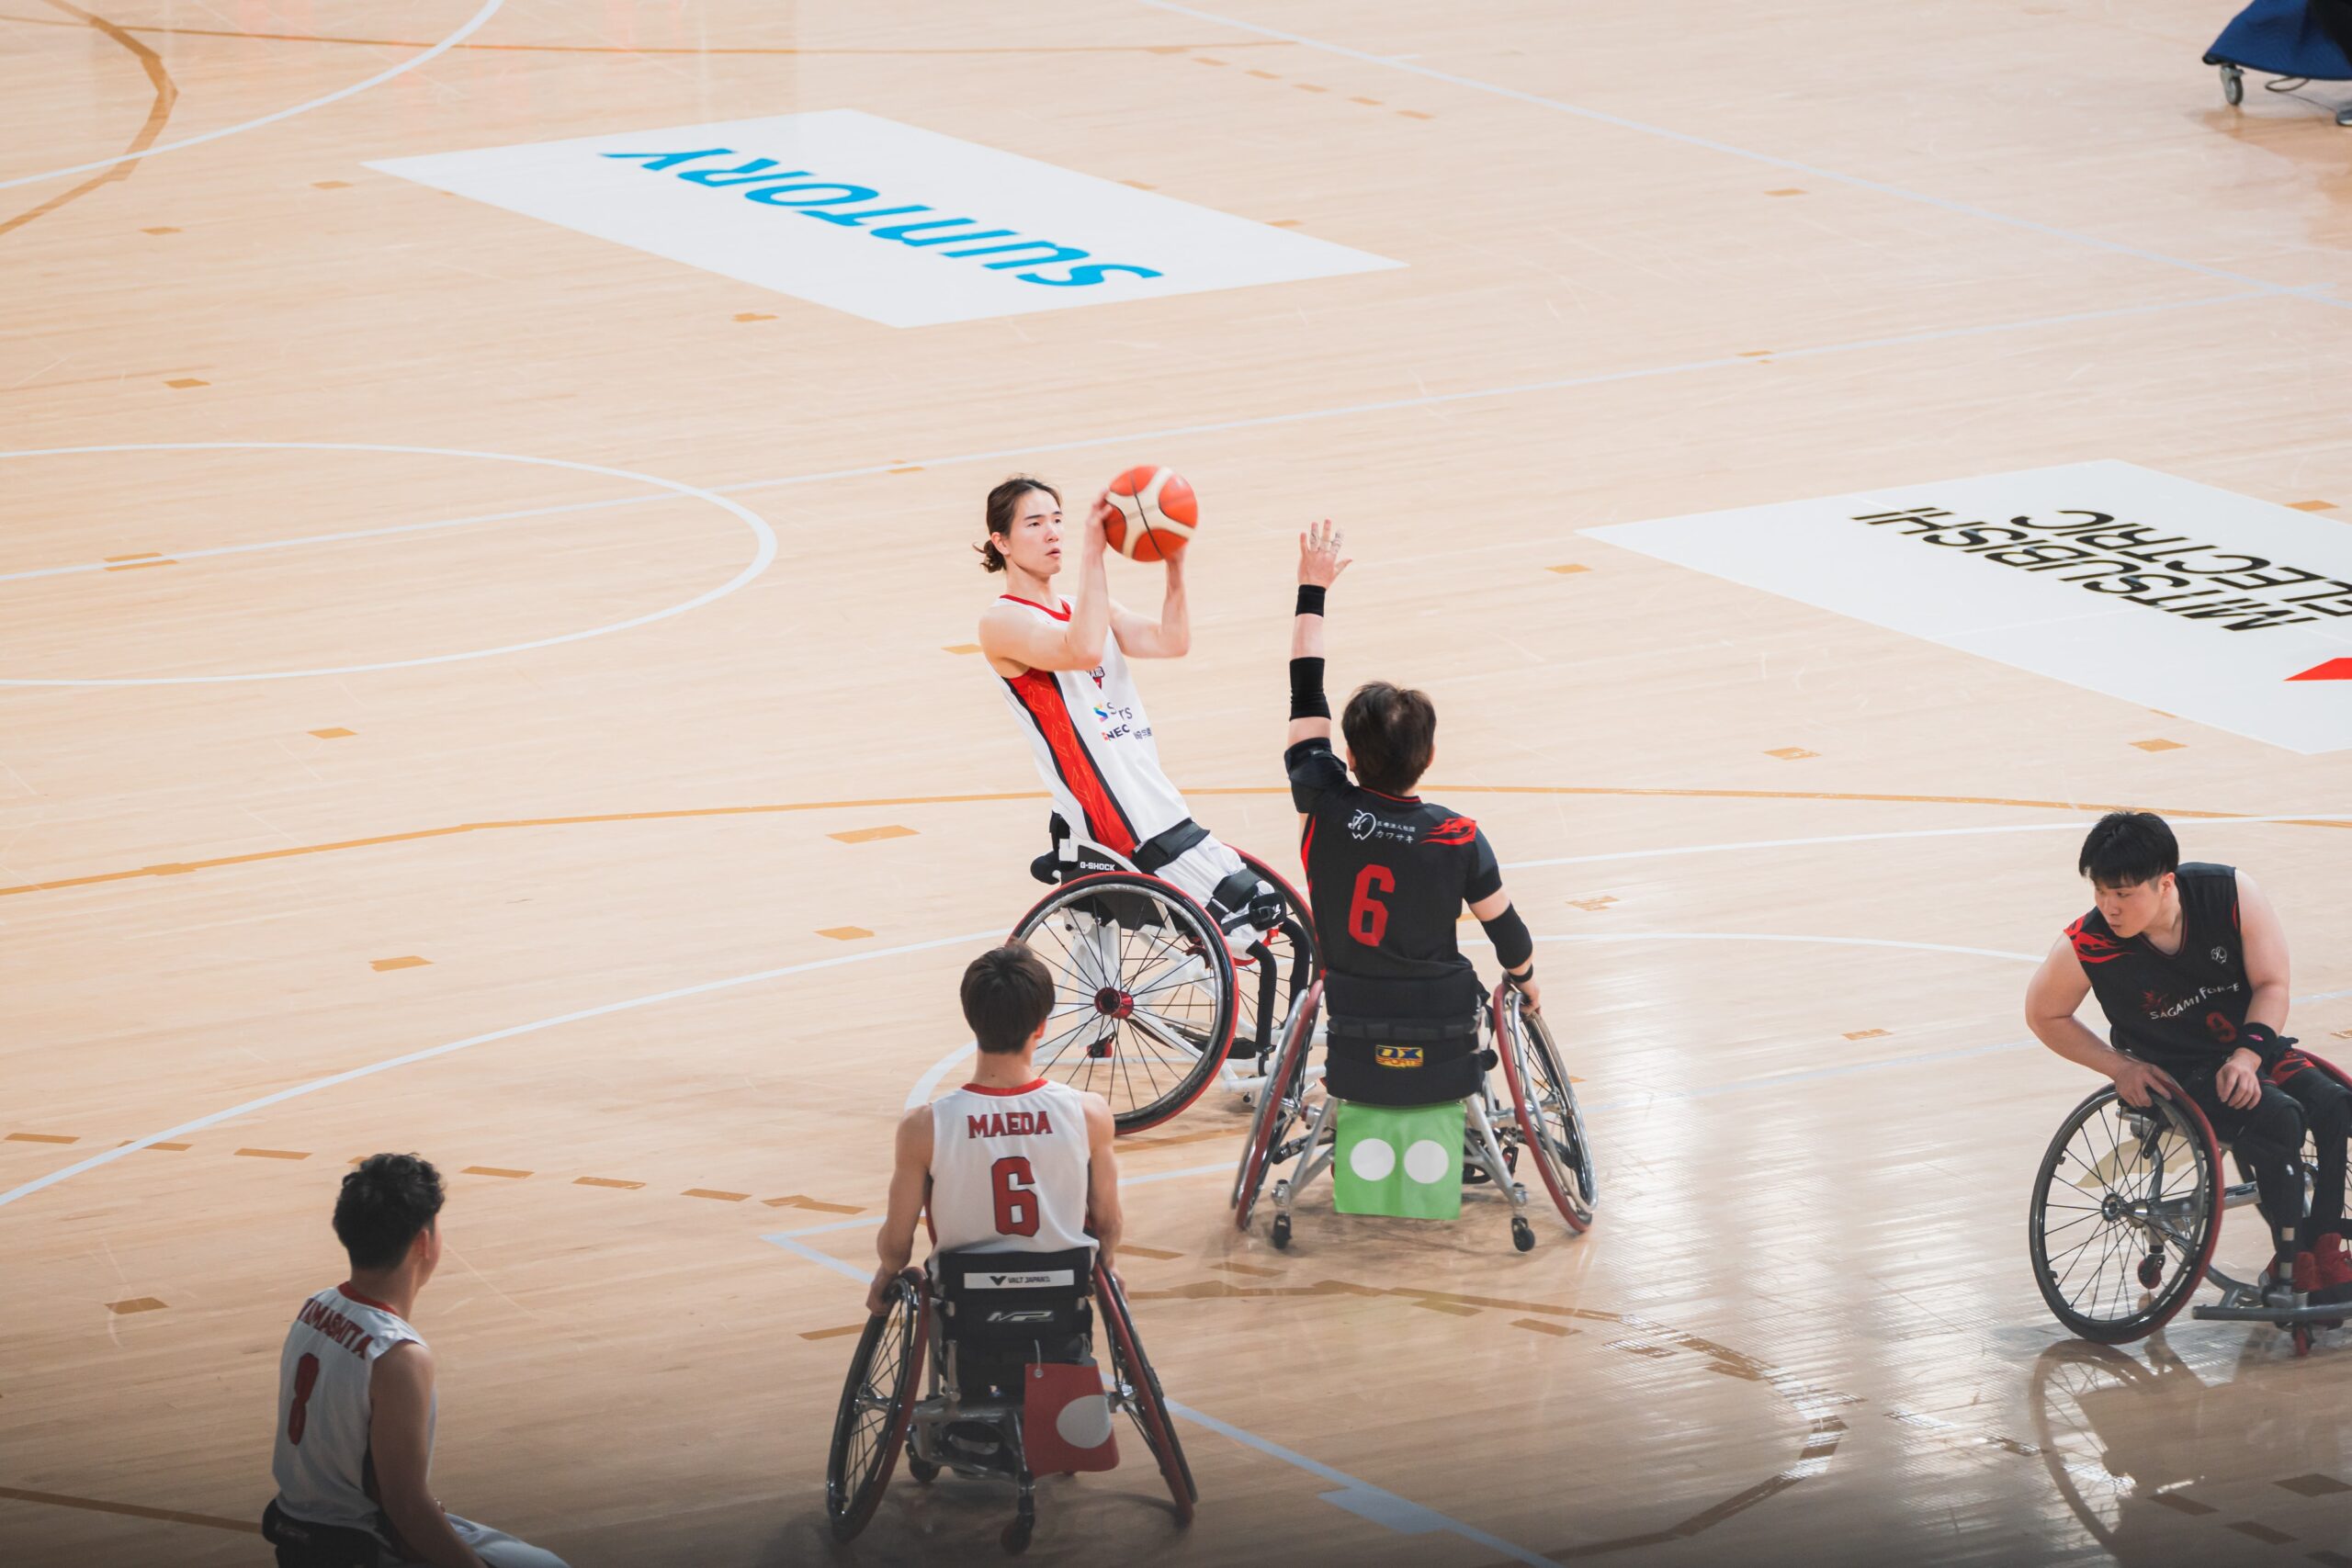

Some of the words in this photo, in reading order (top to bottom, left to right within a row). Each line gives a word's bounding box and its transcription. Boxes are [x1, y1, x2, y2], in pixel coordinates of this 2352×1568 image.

[597, 148, 1164, 287] SUNTORY
[1850, 507, 2319, 631] MITSUBISHI
[1375, 830, 1414, 844] カワサキ
[1080, 862, 1115, 872] G-SHOCK
[1348, 863, 1396, 948] 6
[2150, 996, 2199, 1020] SAGAMI
[967, 1111, 1054, 1138] MAEDA
[990, 1156, 1040, 1237] 6
